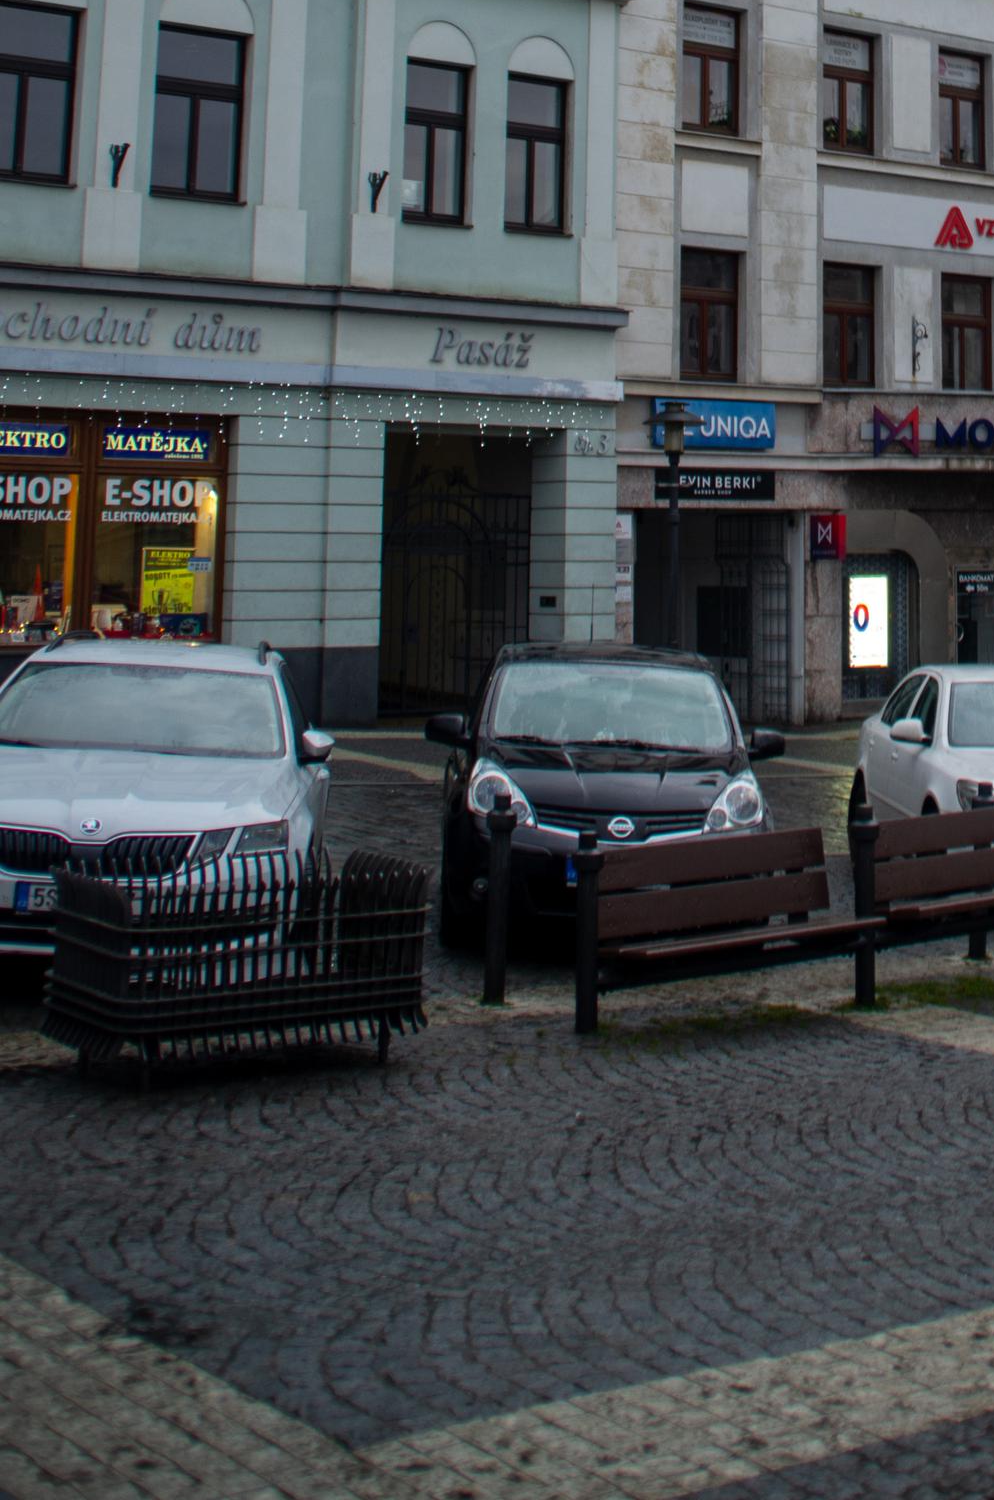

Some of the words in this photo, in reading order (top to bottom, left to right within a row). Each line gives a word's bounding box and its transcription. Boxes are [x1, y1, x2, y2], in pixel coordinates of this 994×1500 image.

[174, 312, 262, 352] dům
[429, 326, 534, 369] Pasáž
[701, 416, 771, 439] UNIQA
[105, 432, 203, 453] MATĚJKA
[0, 474, 72, 505] HOP
[105, 478, 213, 508] E-SHOP
[679, 475, 711, 489] EVIN
[0, 509, 72, 523] MATEJKA.CZ
[34, 887, 57, 907] 5S
